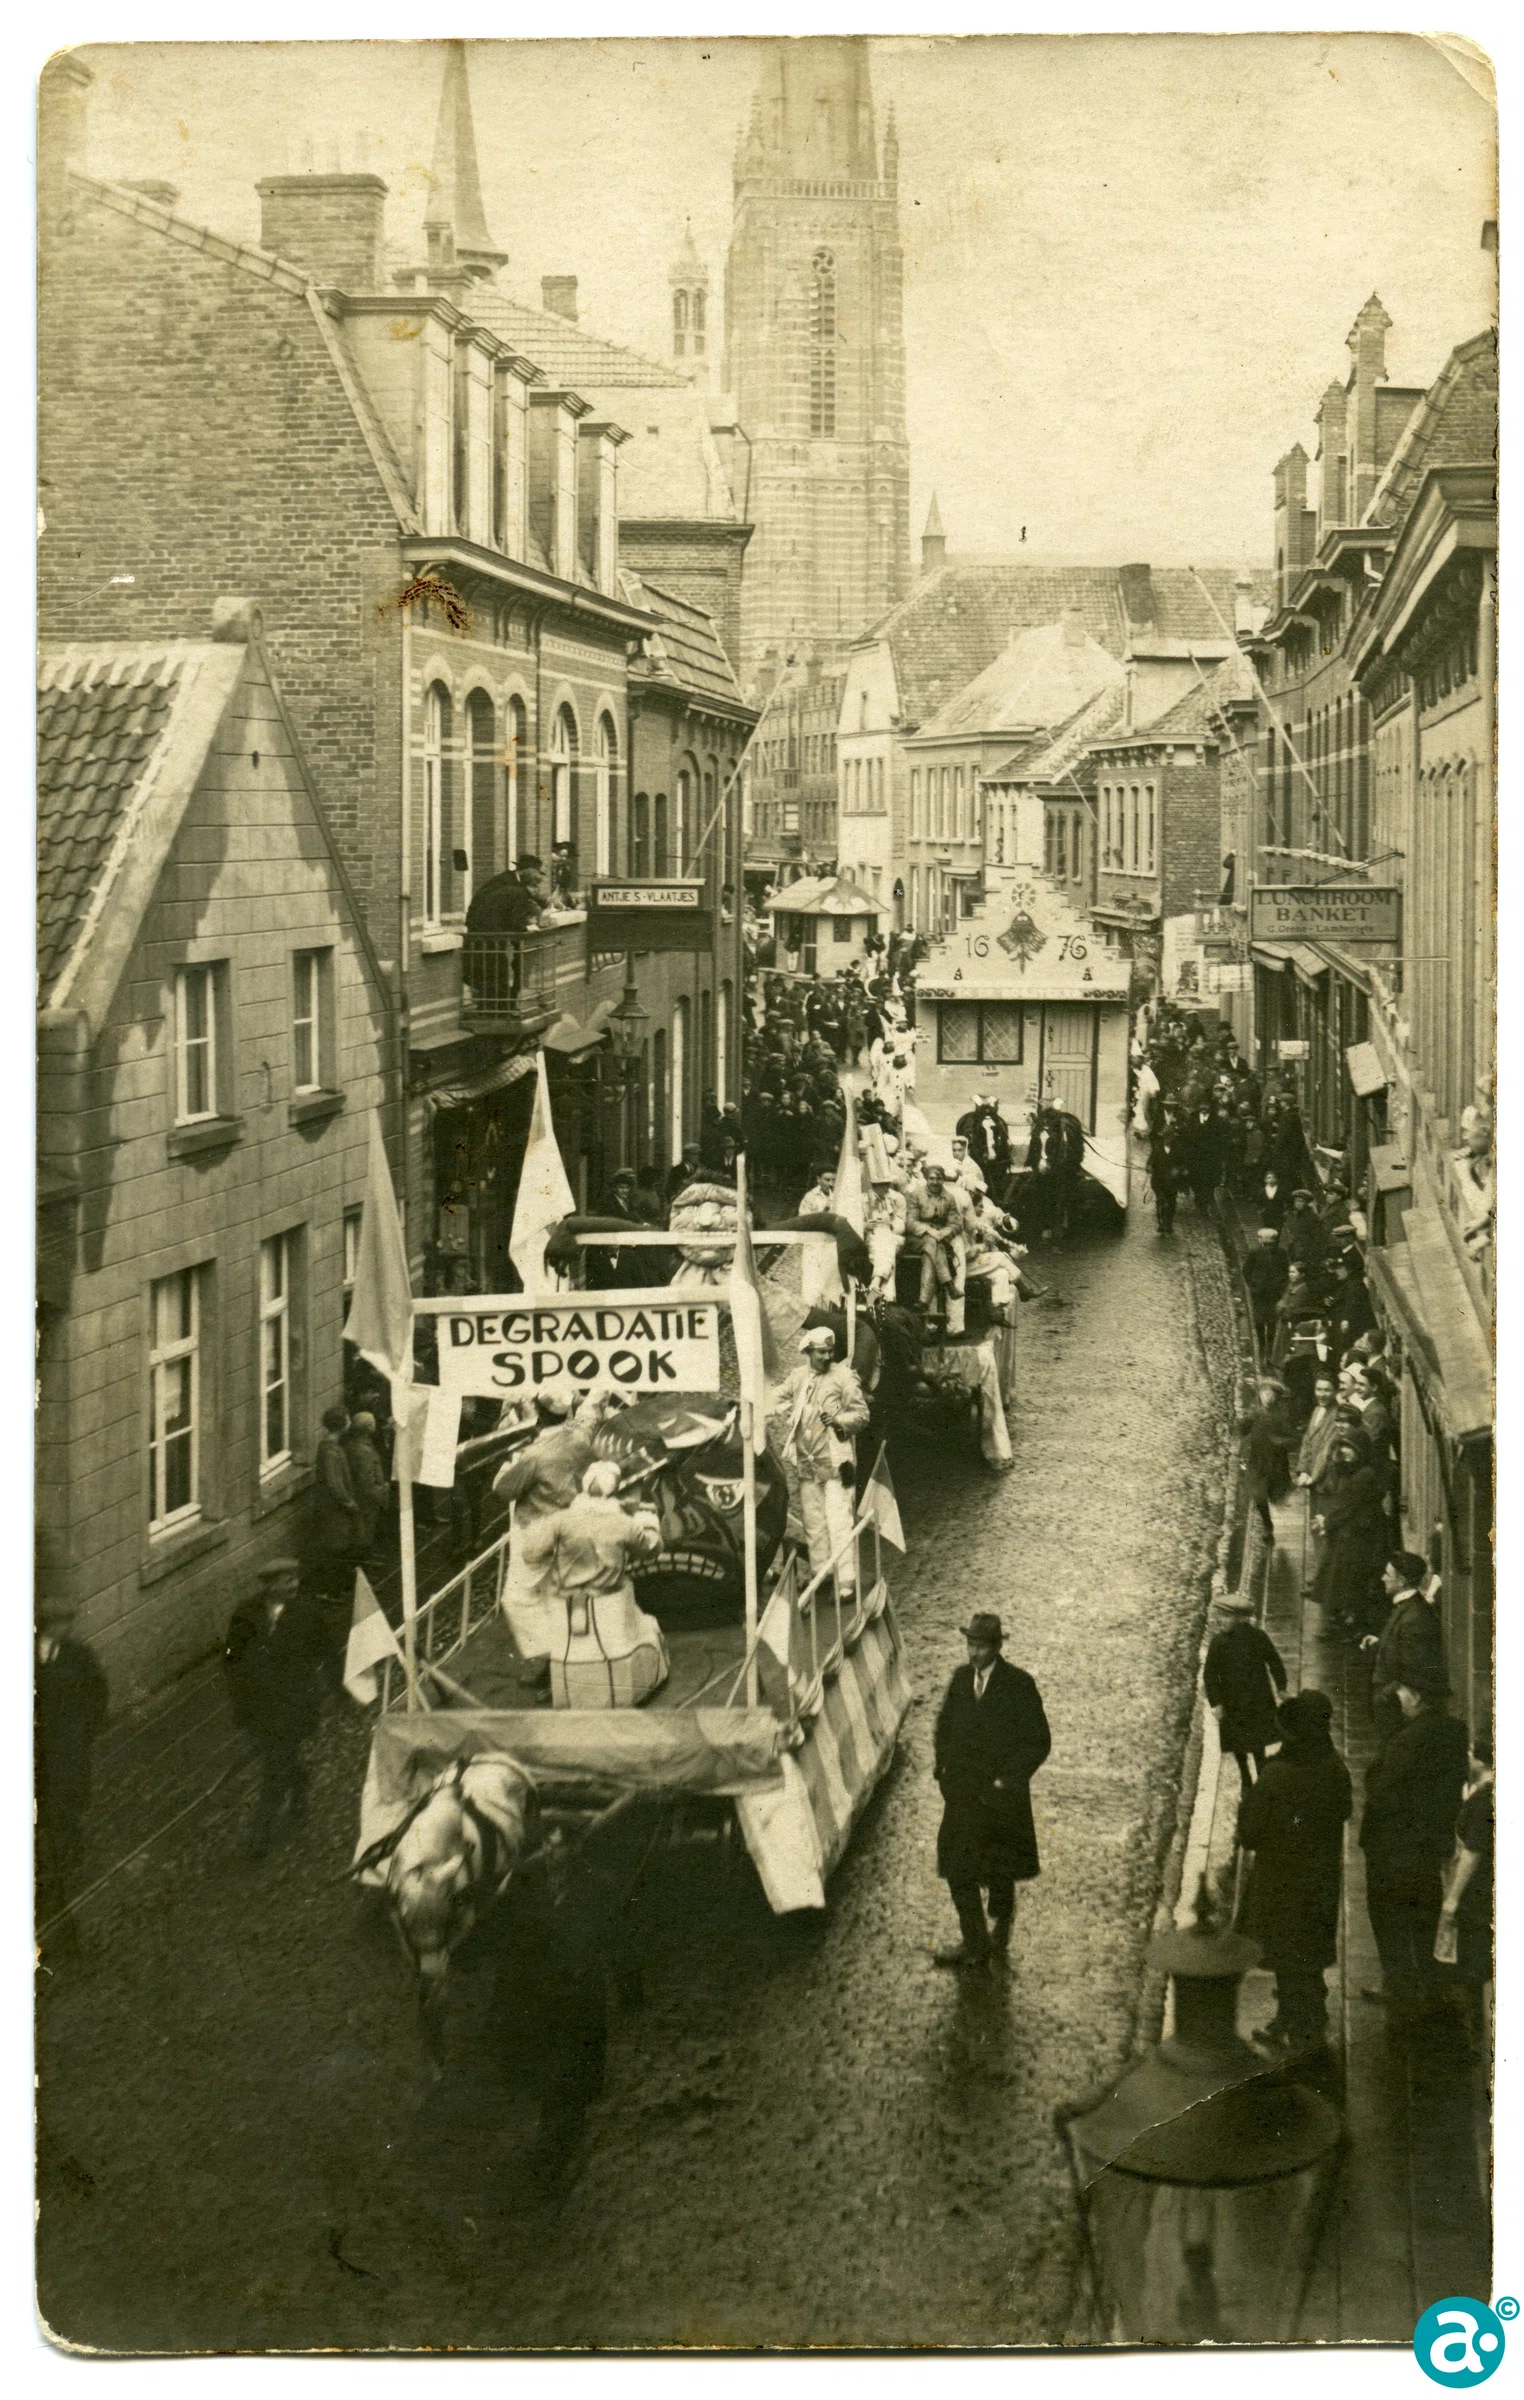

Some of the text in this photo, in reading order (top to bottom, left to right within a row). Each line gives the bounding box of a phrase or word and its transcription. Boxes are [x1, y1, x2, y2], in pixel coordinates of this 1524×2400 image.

[1257, 891, 1392, 906] LUNCHROOM
[1276, 907, 1371, 922] BANKET
[965, 934, 1088, 961] 16 76
[450, 1309, 710, 1347] DEGRADATIE
[491, 1349, 677, 1387] SPOOK
